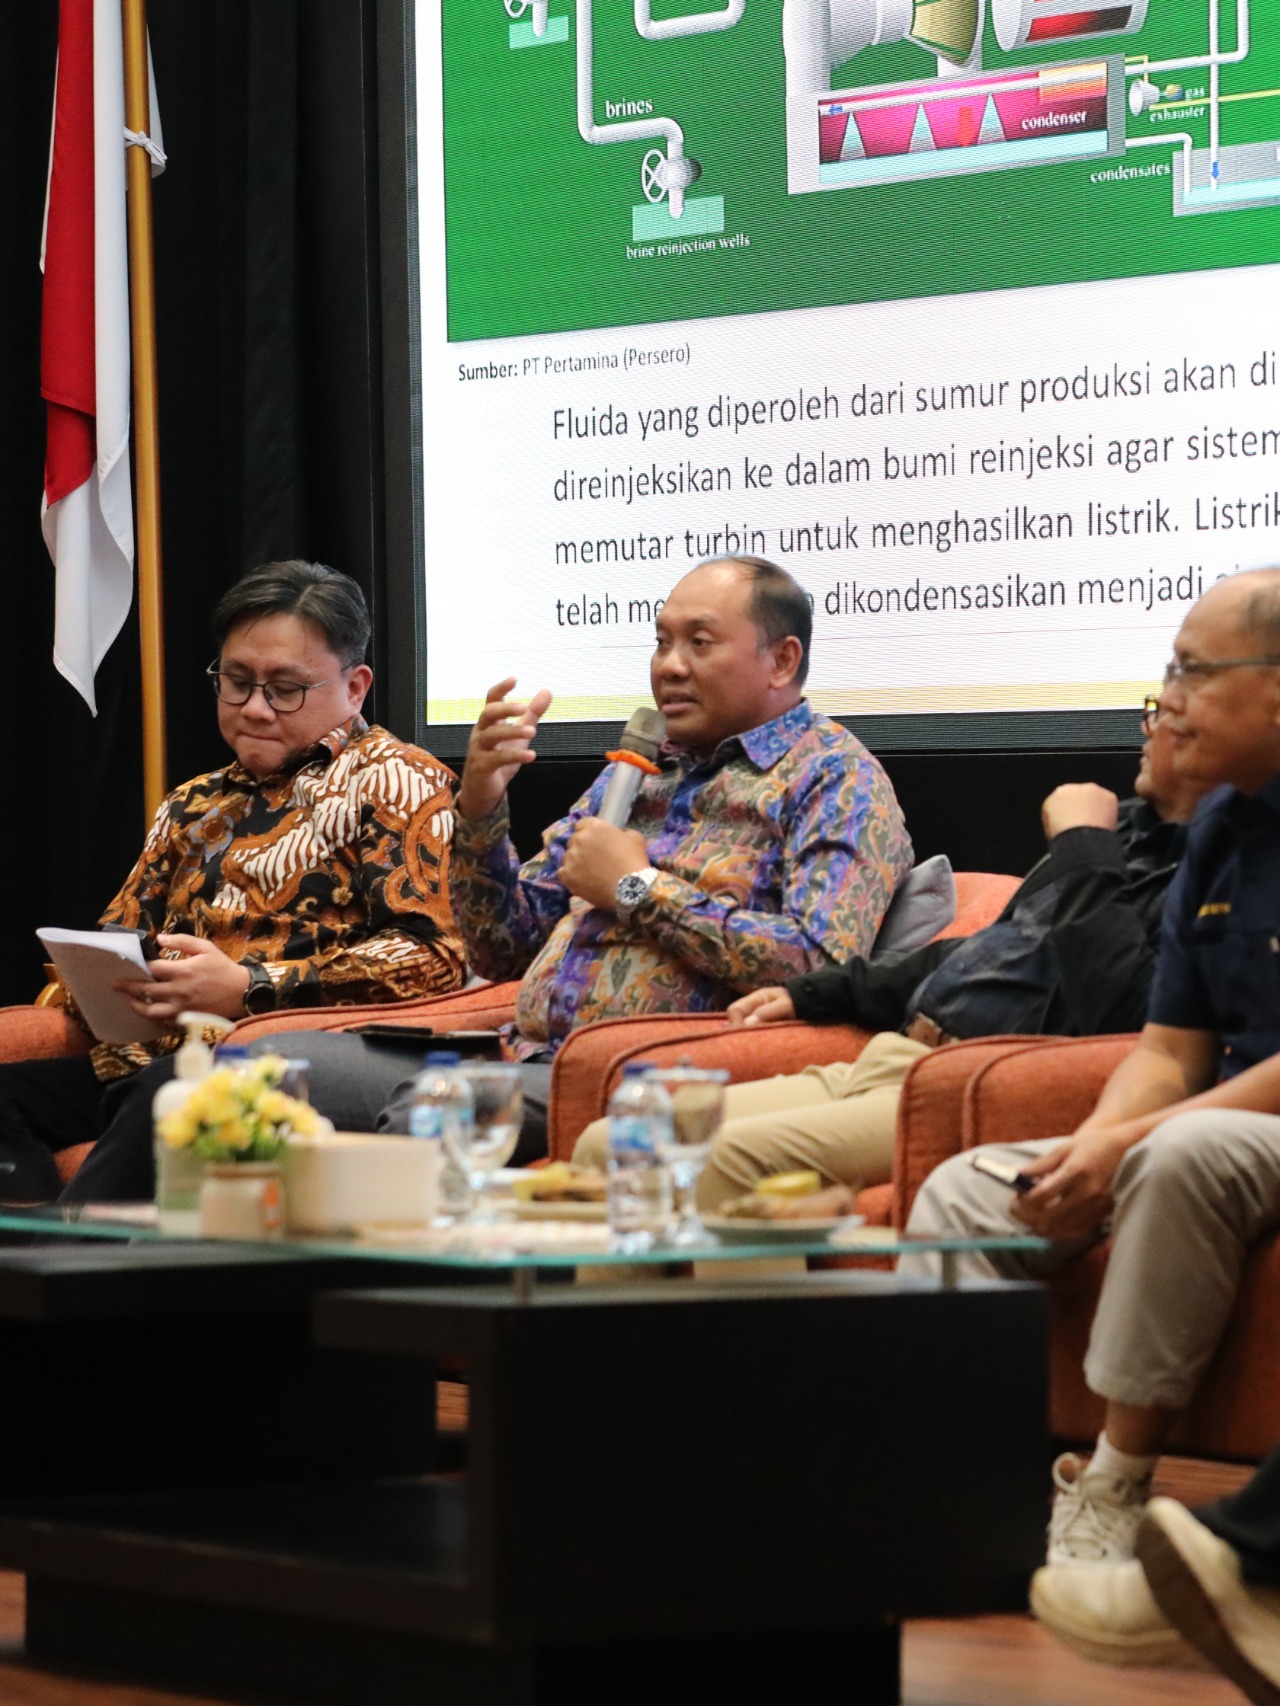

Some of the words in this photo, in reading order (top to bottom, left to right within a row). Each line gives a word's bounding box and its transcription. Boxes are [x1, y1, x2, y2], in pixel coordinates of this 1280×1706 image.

[1184, 86, 1205, 99] gas
[605, 97, 654, 118] brines
[1021, 110, 1087, 130] condenser
[1150, 105, 1205, 123] exhauster
[1090, 161, 1171, 183] condensates
[626, 244, 655, 259] brine
[657, 237, 716, 257] reinjection
[718, 233, 751, 249] wells
[458, 361, 519, 382] Sumber:
[523, 357, 540, 376] PT
[544, 351, 619, 375] Pertamina
[623, 342, 691, 372] (Persero)
[554, 405, 628, 439] Fluida
[638, 406, 699, 440] yang
[708, 387, 838, 433] diperoleh
[851, 382, 903, 417] dari
[916, 381, 1009, 412] sumur
[1021, 363, 1149, 412] produksi
[1164, 358, 1235, 393] akan
[554, 459, 731, 505] direinjeksikan
[745, 457, 772, 488] ke
[786, 452, 870, 486] dalam
[884, 444, 954, 479] bumi
[970, 434, 1092, 479] reinjeksi
[1107, 437, 1174, 473] agar
[556, 534, 674, 563] memutar
[684, 523, 765, 557] turbin
[780, 517, 858, 552] untuk
[872, 506, 1072, 553] menghasilkan
[1088, 499, 1178, 536] listrik.
[556, 594, 618, 626] telah
[825, 574, 1065, 615] dikondensasikan
[1079, 565, 1202, 611] menjadi
